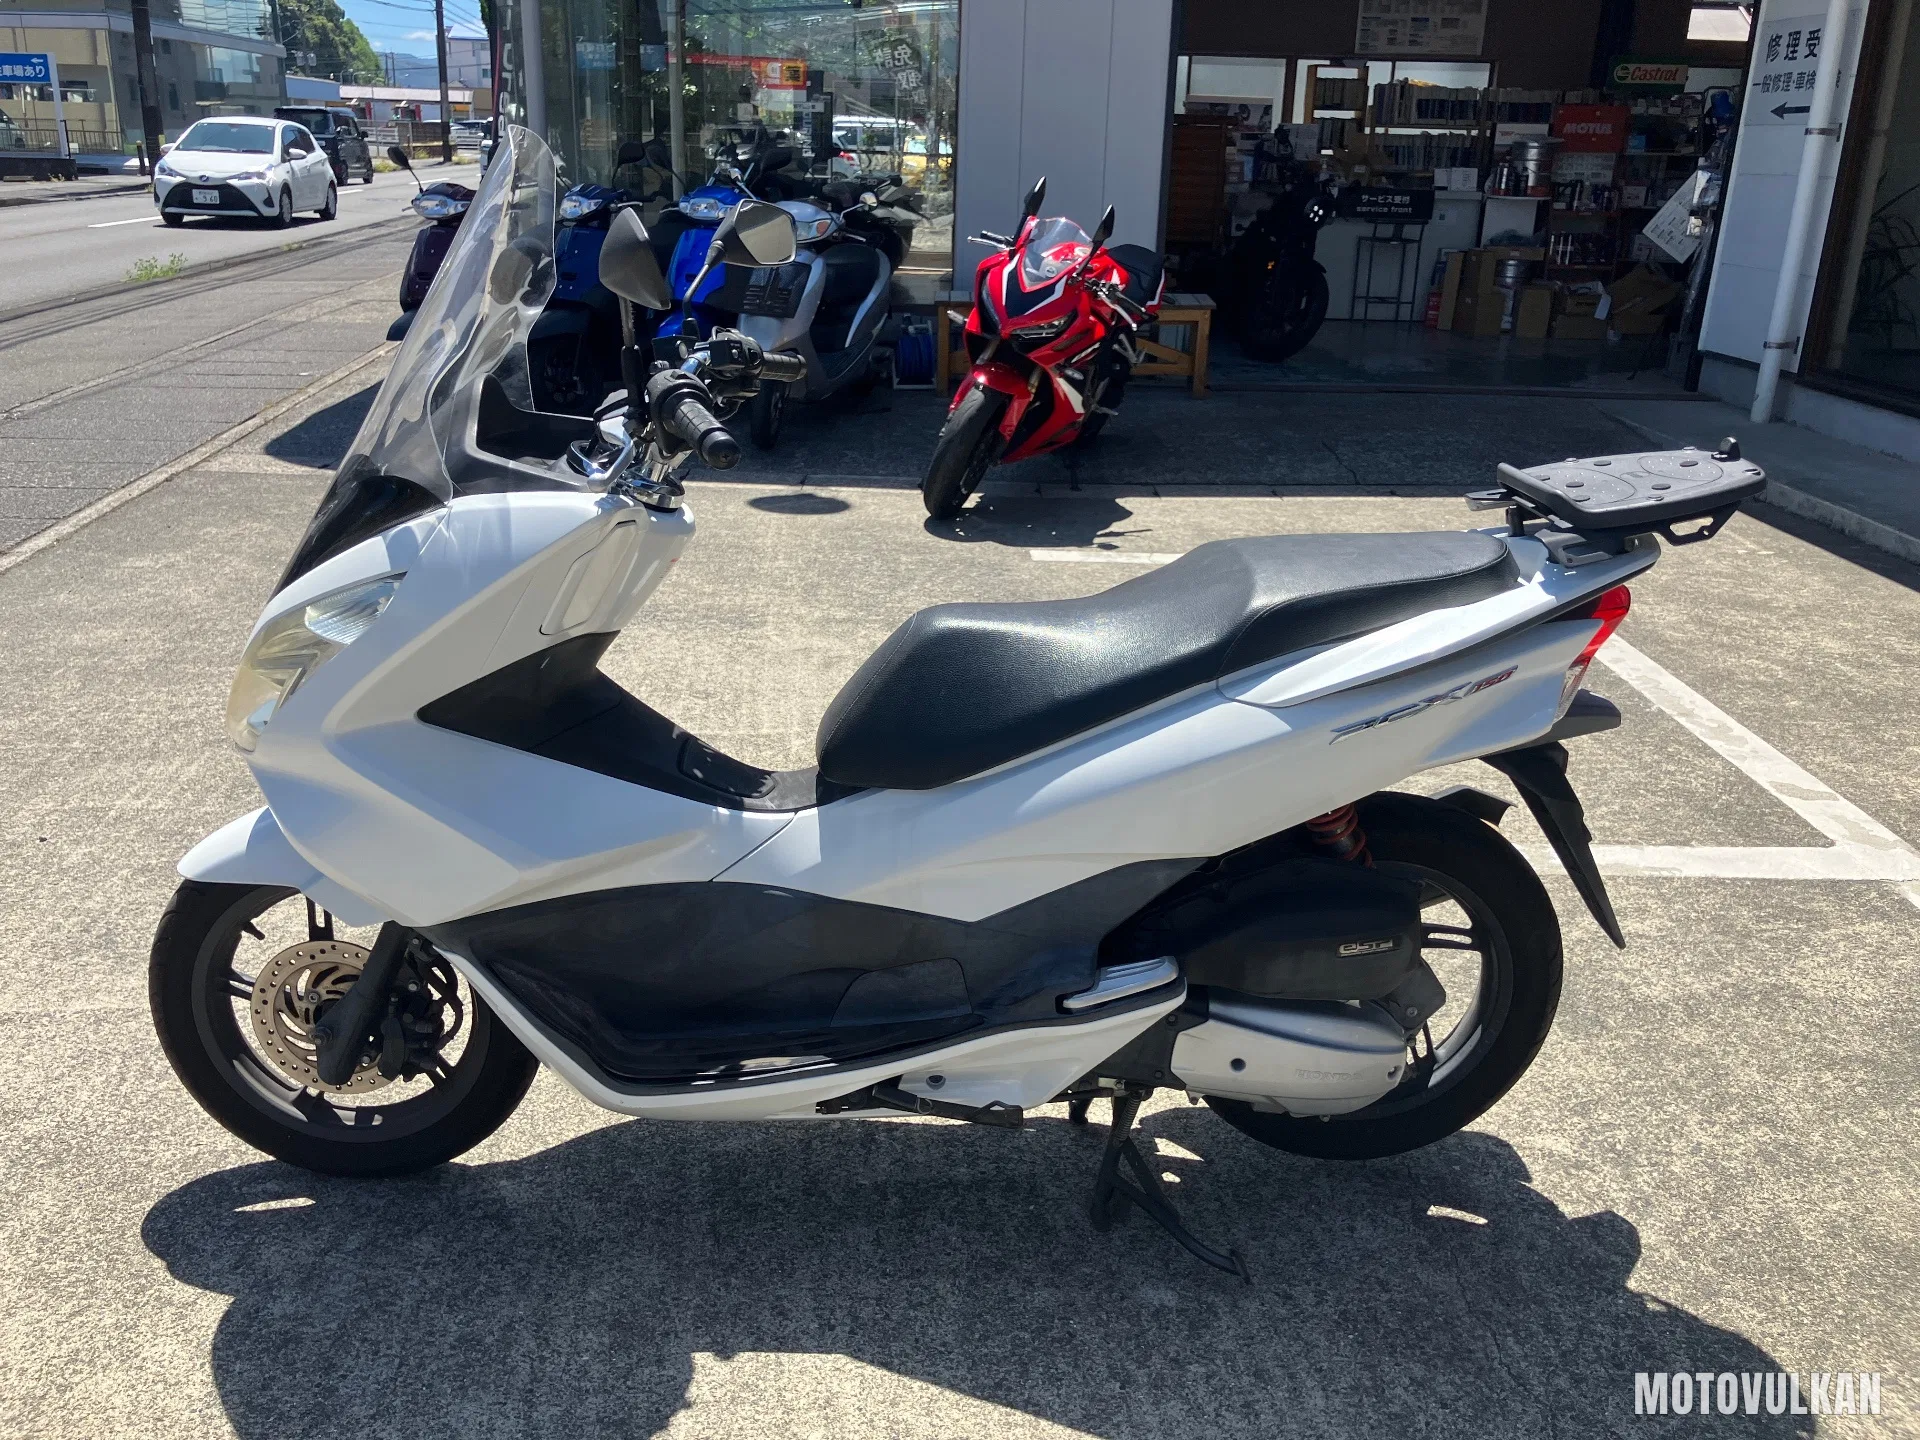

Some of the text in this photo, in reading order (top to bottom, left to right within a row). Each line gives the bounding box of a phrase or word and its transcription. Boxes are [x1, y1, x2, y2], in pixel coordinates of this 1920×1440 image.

[1766, 28, 1822, 63] 修理受
[0, 65, 45, 77] 車場あり
[1631, 66, 1679, 81] Castrol
[1752, 69, 1841, 93] 一般修理・車検
[1563, 123, 1613, 134] MOTUL
[1361, 194, 1411, 204] サービス受付
[1295, 1068, 1364, 1082] HONDA
